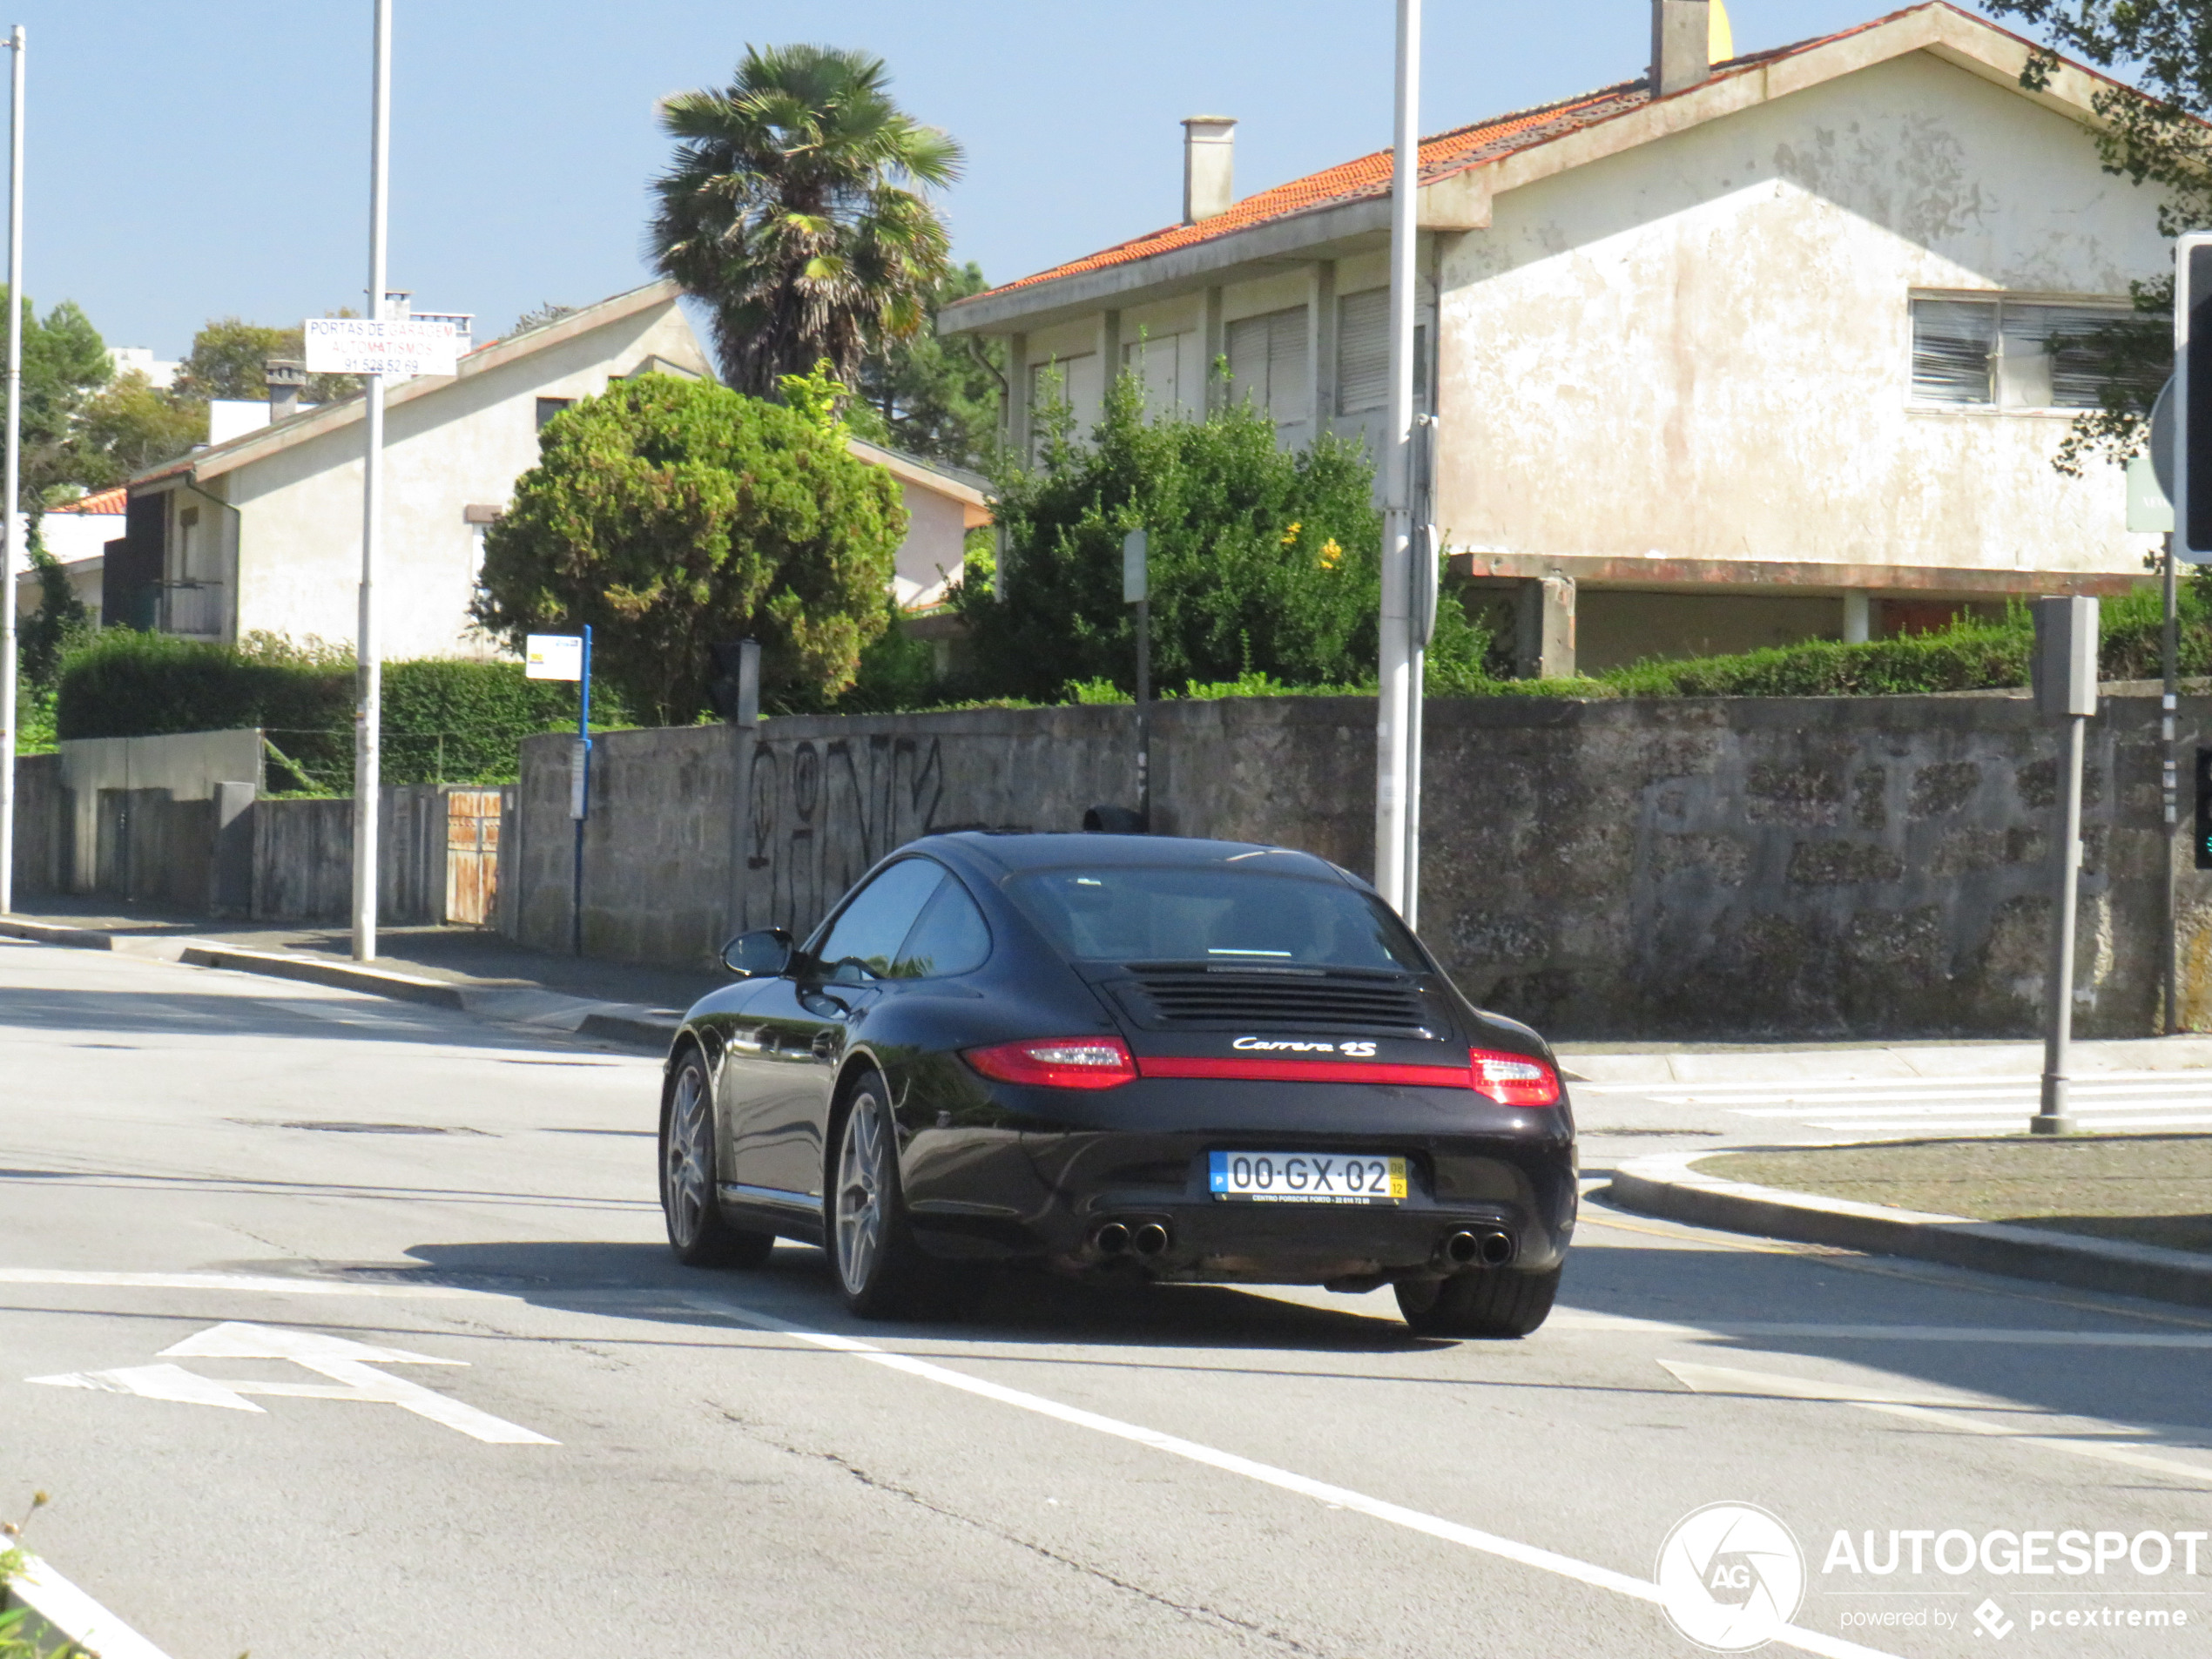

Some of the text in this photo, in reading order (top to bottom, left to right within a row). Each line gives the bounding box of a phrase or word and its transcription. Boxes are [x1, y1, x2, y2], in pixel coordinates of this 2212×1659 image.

[311, 321, 453, 338] PORTAS DE GARAGEM
[332, 341, 433, 355] AUTOMATISMOS
[345, 358, 418, 373] 91 528 52 69
[1232, 1036, 1377, 1057] Carrera 4S
[1391, 1163, 1405, 1174] 08
[1215, 1176, 1224, 1185] P
[1392, 1184, 1403, 1195] 12
[1252, 1194, 1278, 1203] CENTRO
[1278, 1195, 1309, 1204] PORSCHE
